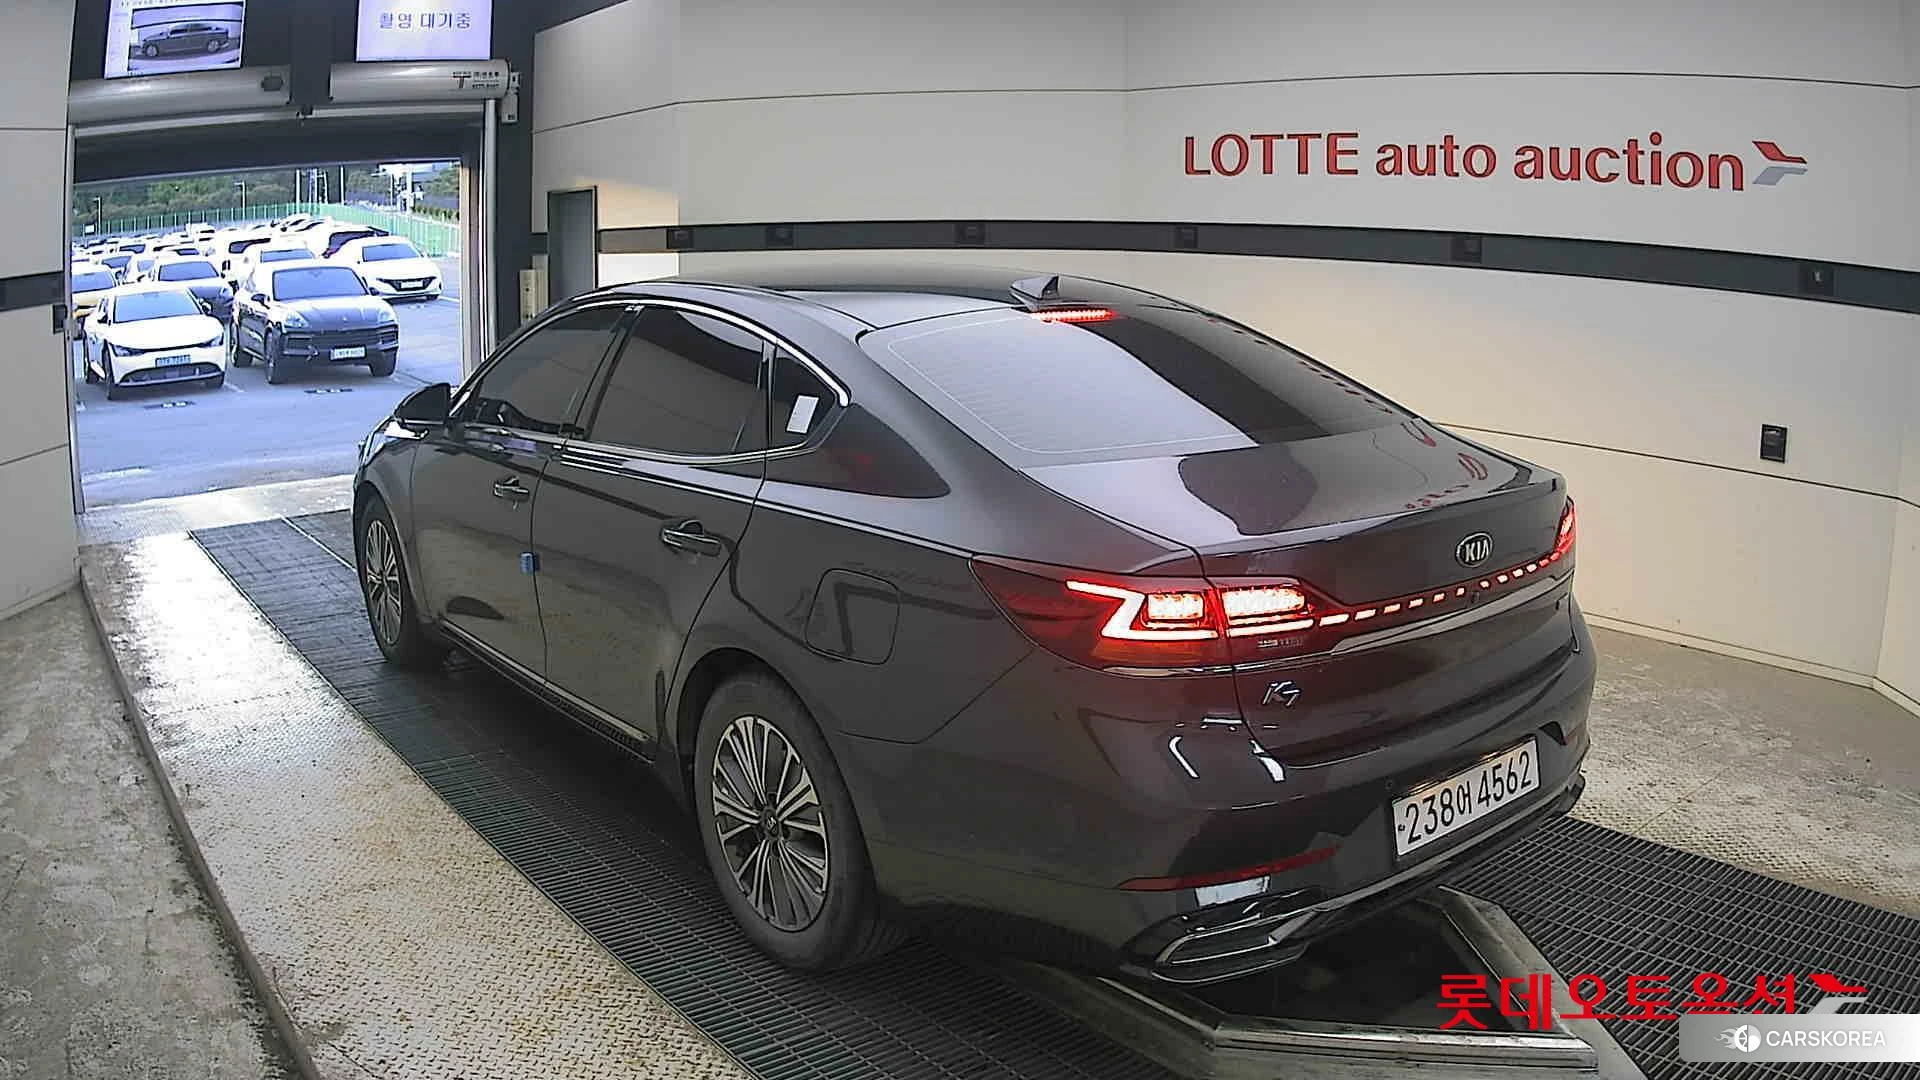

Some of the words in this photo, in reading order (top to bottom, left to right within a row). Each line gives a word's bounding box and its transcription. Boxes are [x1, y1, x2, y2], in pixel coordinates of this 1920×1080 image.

[1184, 132, 1359, 176] LOTTE
[1376, 135, 1496, 177] auto
[1513, 131, 1744, 192] auction
[1465, 539, 1489, 562] KIA
[1262, 681, 1300, 706] K7
[1405, 780, 1472, 845] 238어
[1477, 750, 1532, 808] 4562
